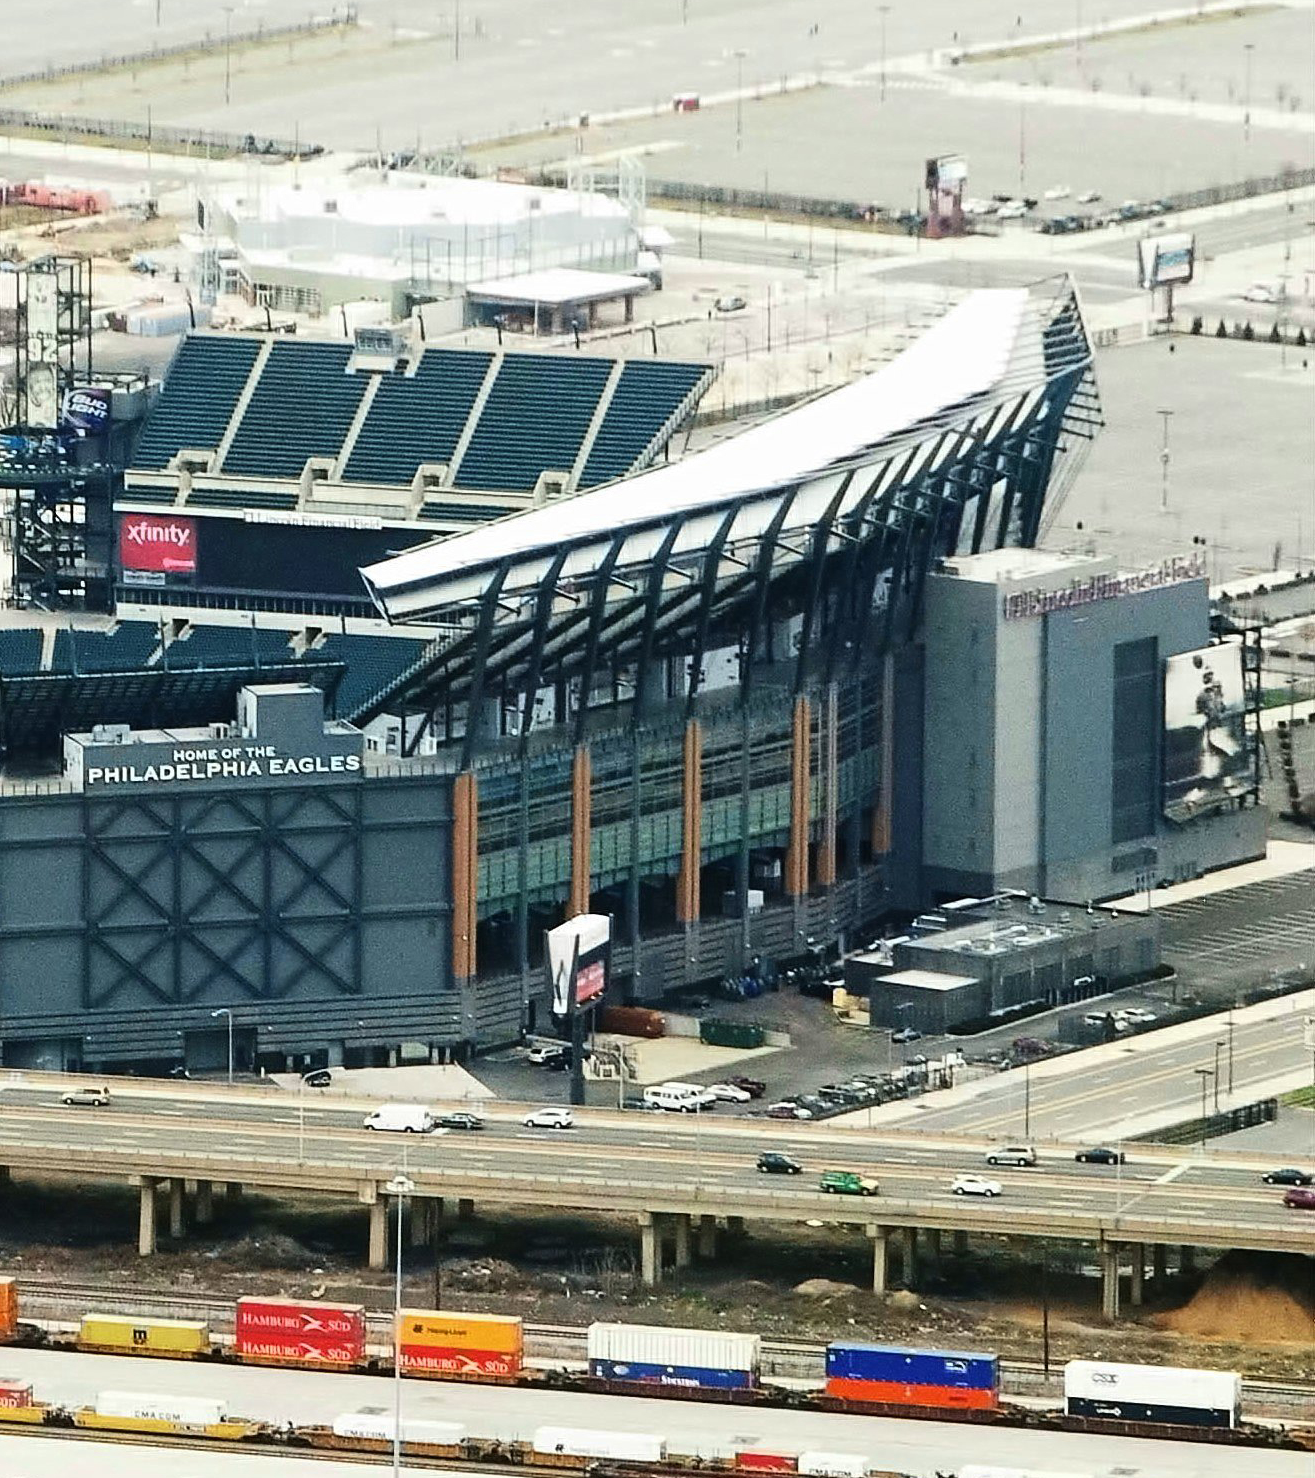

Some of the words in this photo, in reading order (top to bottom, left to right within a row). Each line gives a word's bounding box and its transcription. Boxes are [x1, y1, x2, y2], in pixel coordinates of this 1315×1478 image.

[28, 338, 57, 363] 92
[72, 394, 108, 410] BUD
[173, 749, 217, 762] HOME
[222, 748, 241, 760] OF
[245, 746, 275, 758] THE
[88, 760, 262, 784] PHILADELPHIA
[269, 755, 361, 775] EAGLES
[242, 1312, 300, 1329] HAMBURG
[242, 1341, 300, 1357] HAMBURG
[399, 1354, 458, 1370] HAMBURG
[1091, 1372, 1120, 1385] CSX
[134, 1410, 156, 1419] CMA
